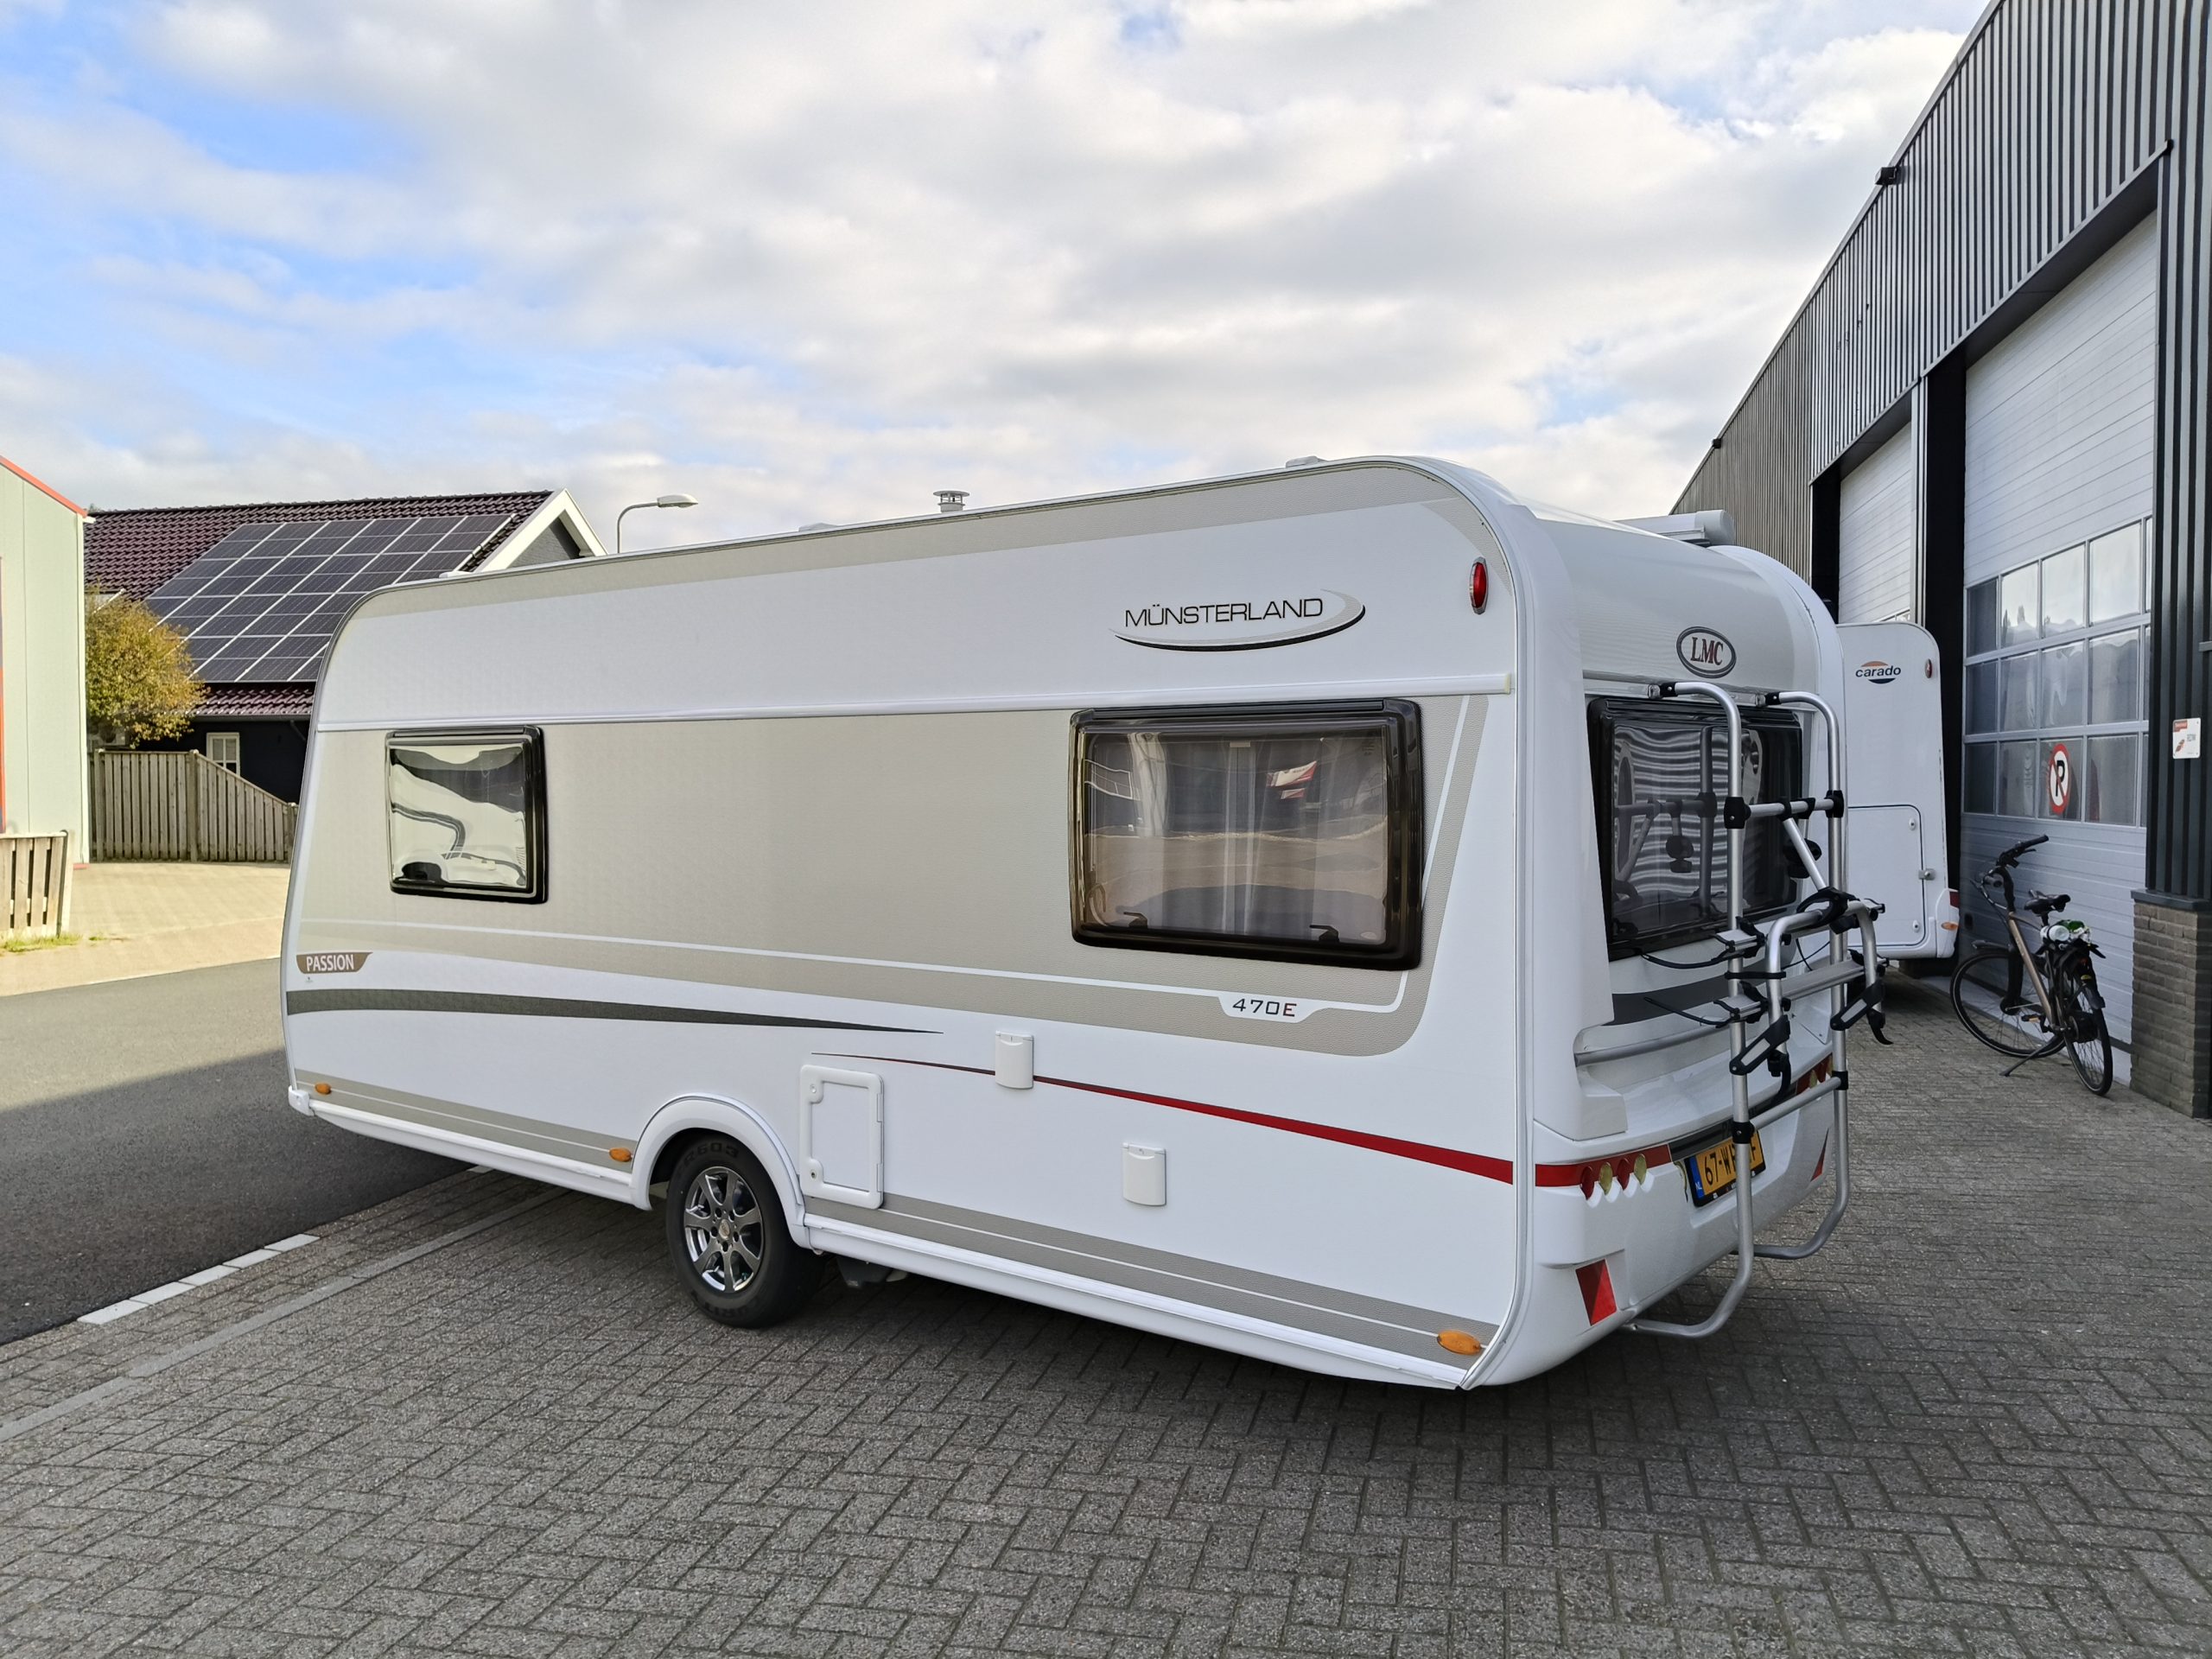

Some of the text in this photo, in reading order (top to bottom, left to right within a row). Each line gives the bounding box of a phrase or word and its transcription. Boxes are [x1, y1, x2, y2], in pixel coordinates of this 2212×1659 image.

[1125, 598, 1324, 627] MÜNSTERLAND
[1690, 637, 1724, 666] LMC
[1855, 664, 1902, 678] carado
[306, 954, 354, 972] PASSION
[1232, 998, 1298, 1017] 470E
